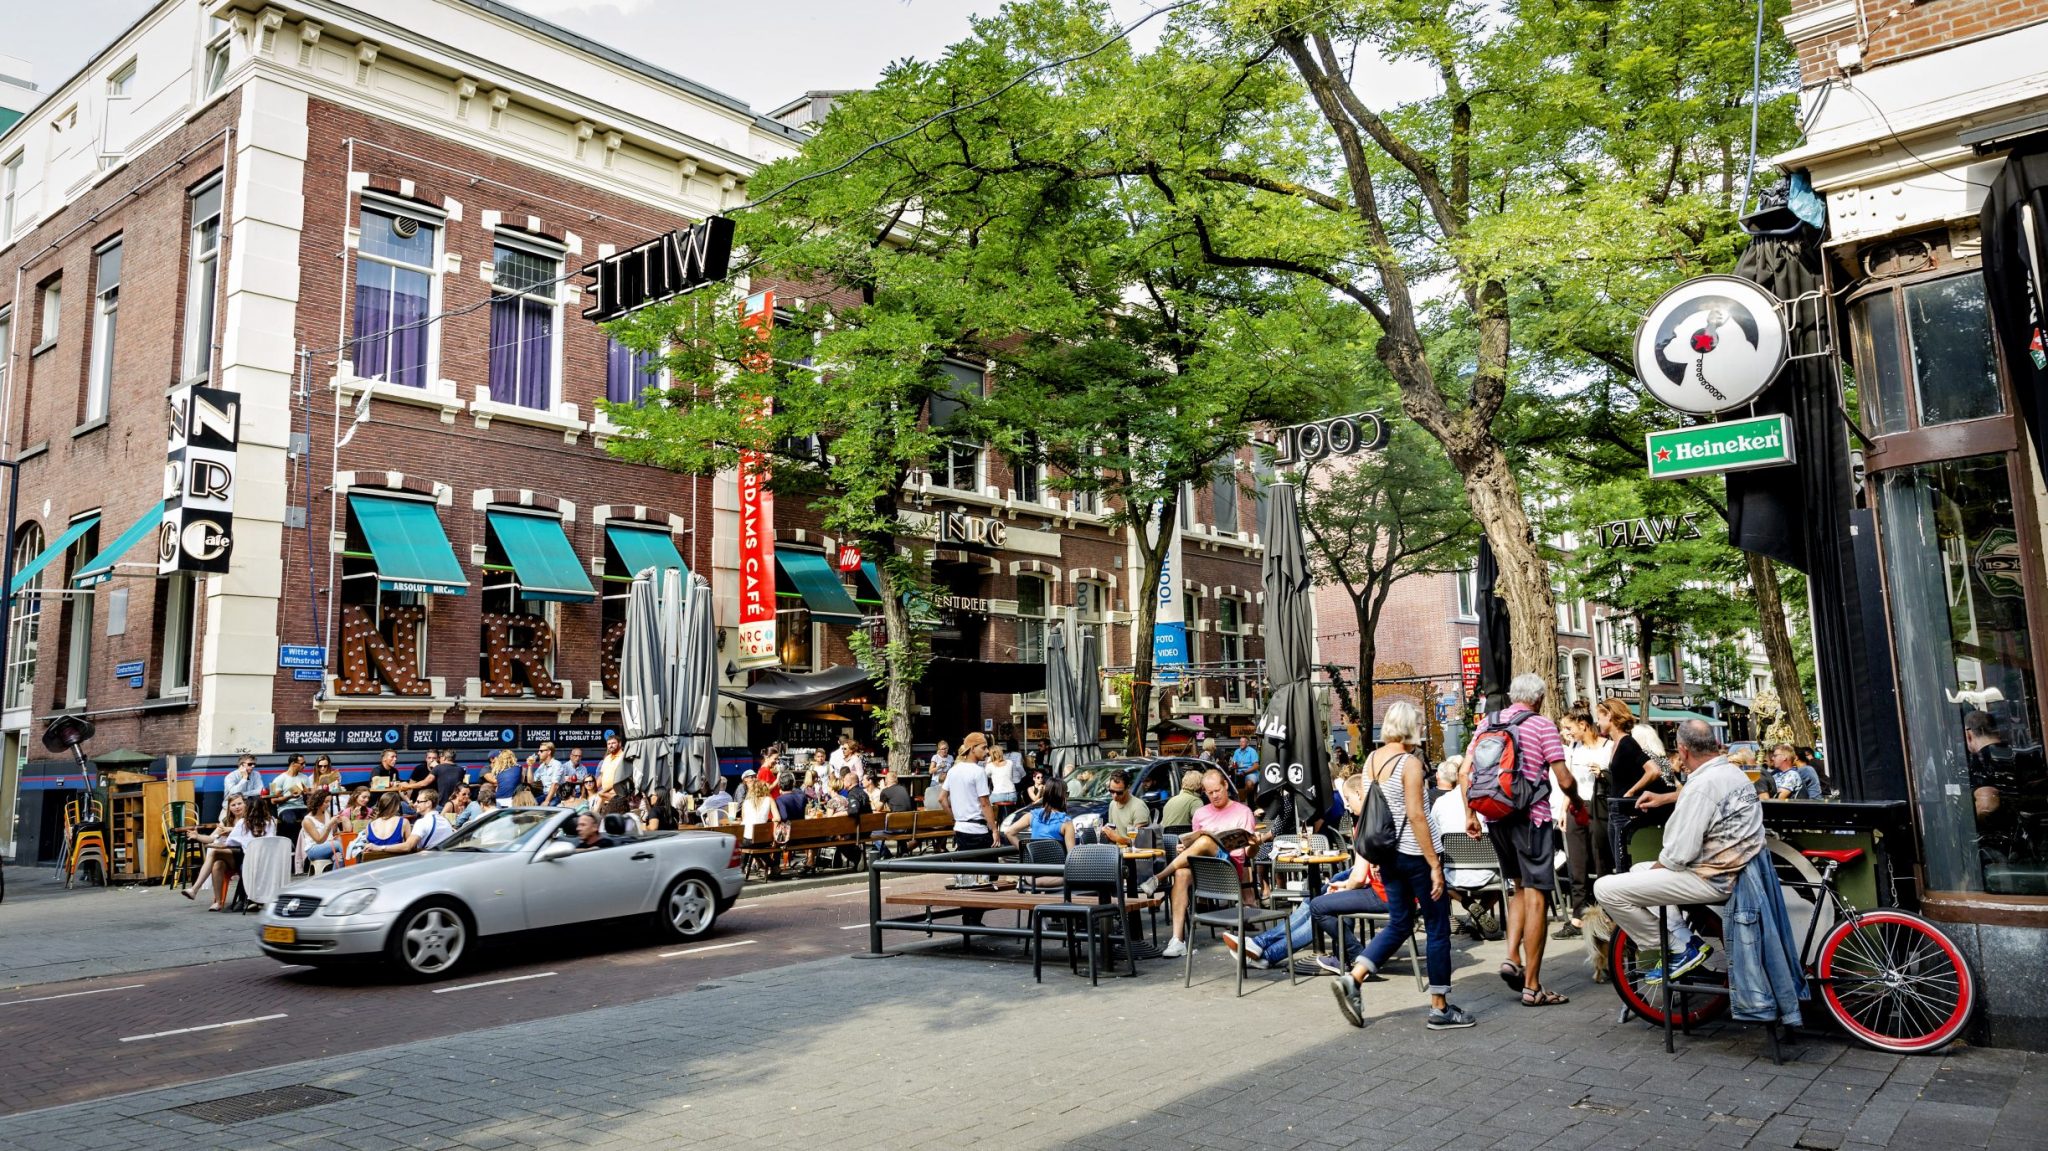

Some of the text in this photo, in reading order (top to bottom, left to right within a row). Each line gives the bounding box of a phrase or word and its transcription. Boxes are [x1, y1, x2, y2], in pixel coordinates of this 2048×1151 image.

[1675, 433, 1781, 460] Heineken
[841, 549, 860, 569] illy
[393, 582, 427, 592] ABSOLUT
[746, 557, 765, 616] CAFÉ
[739, 630, 761, 643] NRC
[1156, 635, 1174, 643] FOTO
[288, 648, 308, 656] Witte
[1158, 649, 1178, 657] VIDEO
[284, 656, 322, 665] Withstraat
[441, 730, 457, 738] KOP
